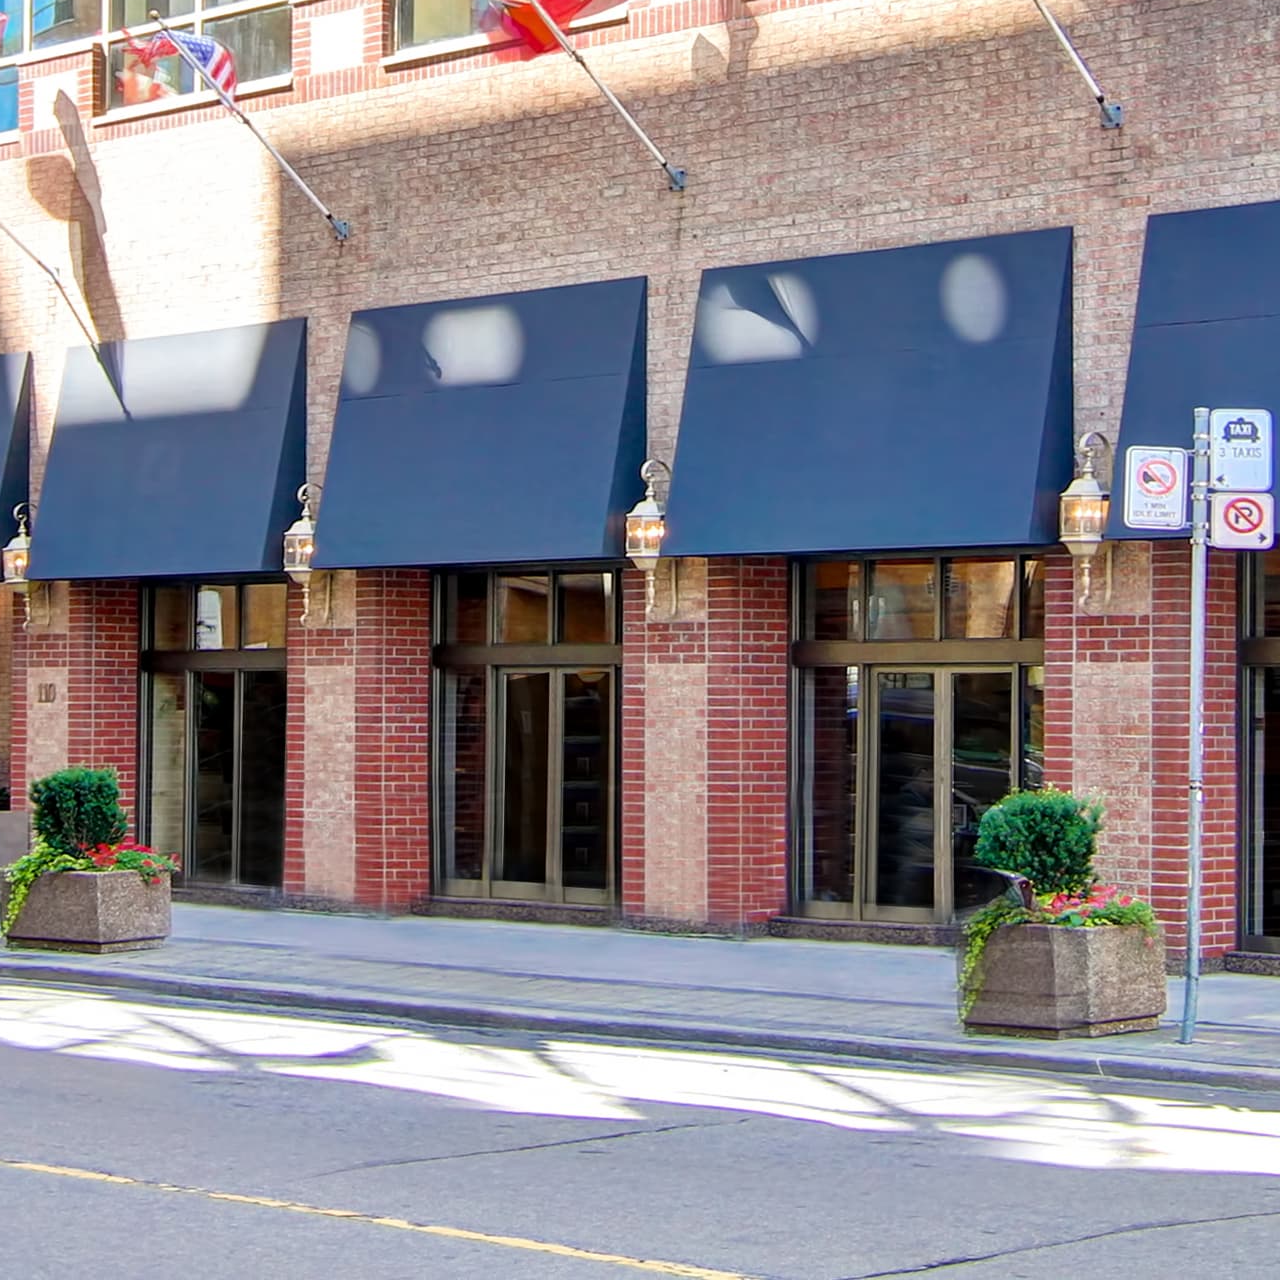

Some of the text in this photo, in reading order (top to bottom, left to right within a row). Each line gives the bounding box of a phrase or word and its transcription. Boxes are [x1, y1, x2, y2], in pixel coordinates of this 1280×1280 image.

[1229, 423, 1253, 435] TAXI
[1219, 447, 1262, 458] 3 TAXIS
